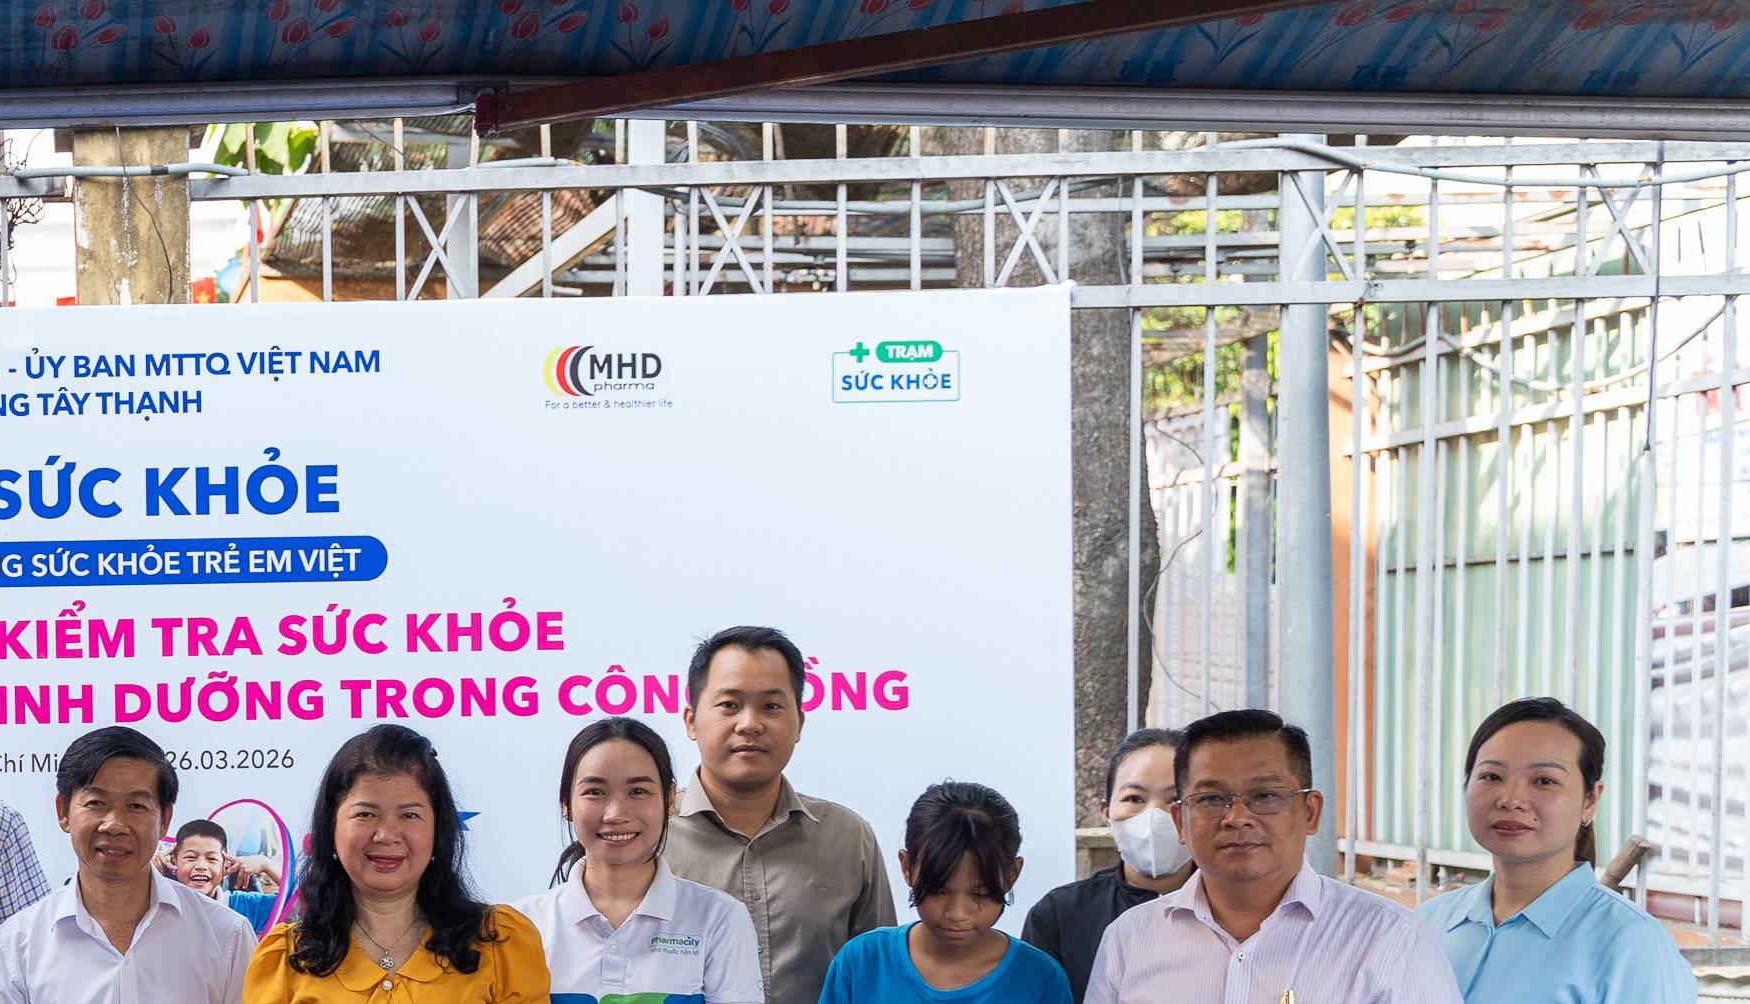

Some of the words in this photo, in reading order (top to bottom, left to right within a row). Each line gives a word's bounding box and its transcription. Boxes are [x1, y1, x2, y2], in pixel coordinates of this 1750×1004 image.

[26, 348, 66, 379] ỦY
[74, 355, 135, 378] BAN
[146, 353, 231, 376] MTTQ
[237, 346, 302, 381] VIỆT
[310, 350, 379, 373] NAM
[590, 353, 661, 379] MHD
[884, 343, 934, 361] TRẠM
[594, 381, 655, 392] pharma
[842, 371, 883, 390] SỨC
[891, 368, 951, 389] KHỎE
[37, 387, 91, 415] TÂY
[97, 391, 201, 421] THẠNH
[146, 447, 339, 516] KHỎE
[32, 548, 89, 577] SỨC
[98, 545, 180, 575] KHỎE
[187, 543, 240, 573] TRẺ
[249, 550, 291, 572] EM
[298, 544, 361, 578] VIỆT
[152, 617, 263, 656] TRA
[277, 603, 388, 655] SỨC
[405, 597, 565, 653] KHỎE
[115, 670, 325, 722] DƯỠNG
[341, 677, 539, 718] TRONG
